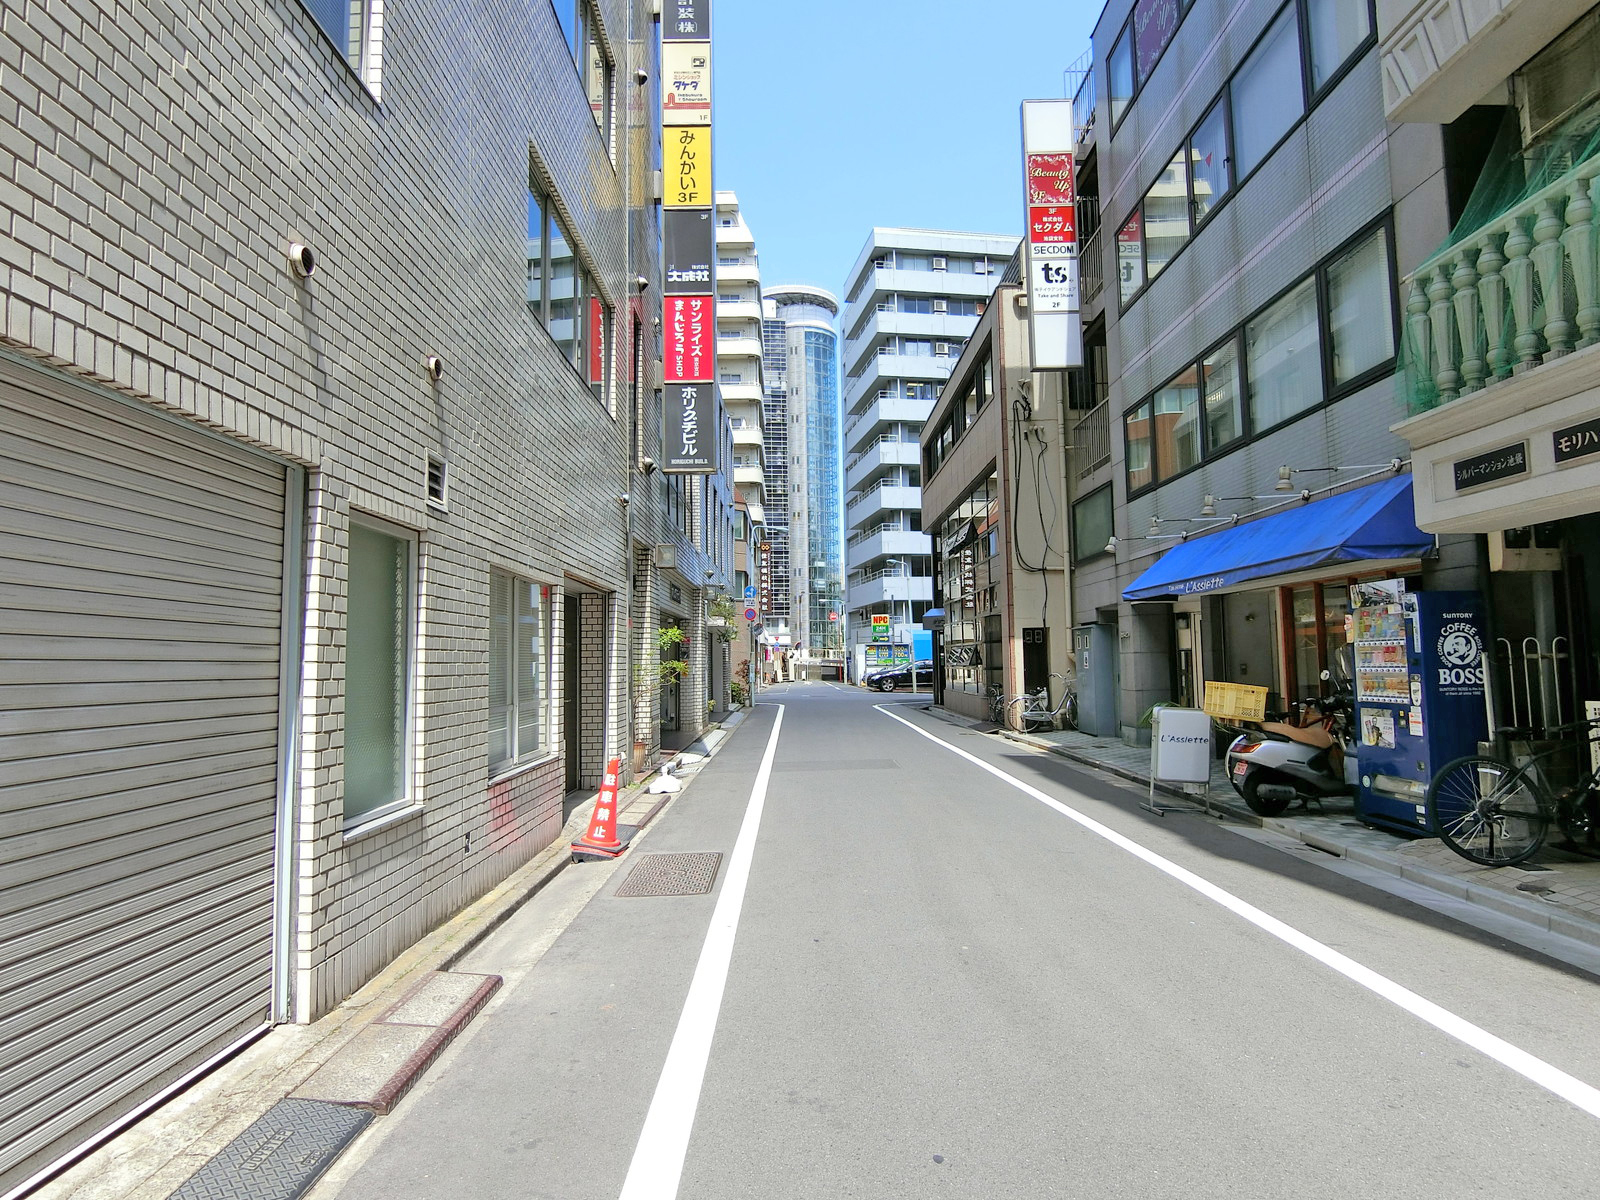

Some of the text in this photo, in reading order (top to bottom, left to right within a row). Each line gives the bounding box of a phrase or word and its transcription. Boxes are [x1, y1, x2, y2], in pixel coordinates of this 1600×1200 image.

[680, 130, 696, 190] みんかい
[1031, 168, 1070, 180] Beauty
[678, 192, 698, 203] 3F
[1033, 222, 1074, 232] セクダム
[1034, 246, 1074, 254] SECDOM
[674, 300, 685, 354] まんじろう
[690, 300, 702, 357] サンライズ
[682, 386, 698, 456] ホリグチビル
[1558, 430, 1600, 452] モリハ
[1456, 453, 1524, 480] シルバーマンション池袋
[1440, 622, 1478, 636] COFFEE
[1438, 668, 1484, 684] BOSS
